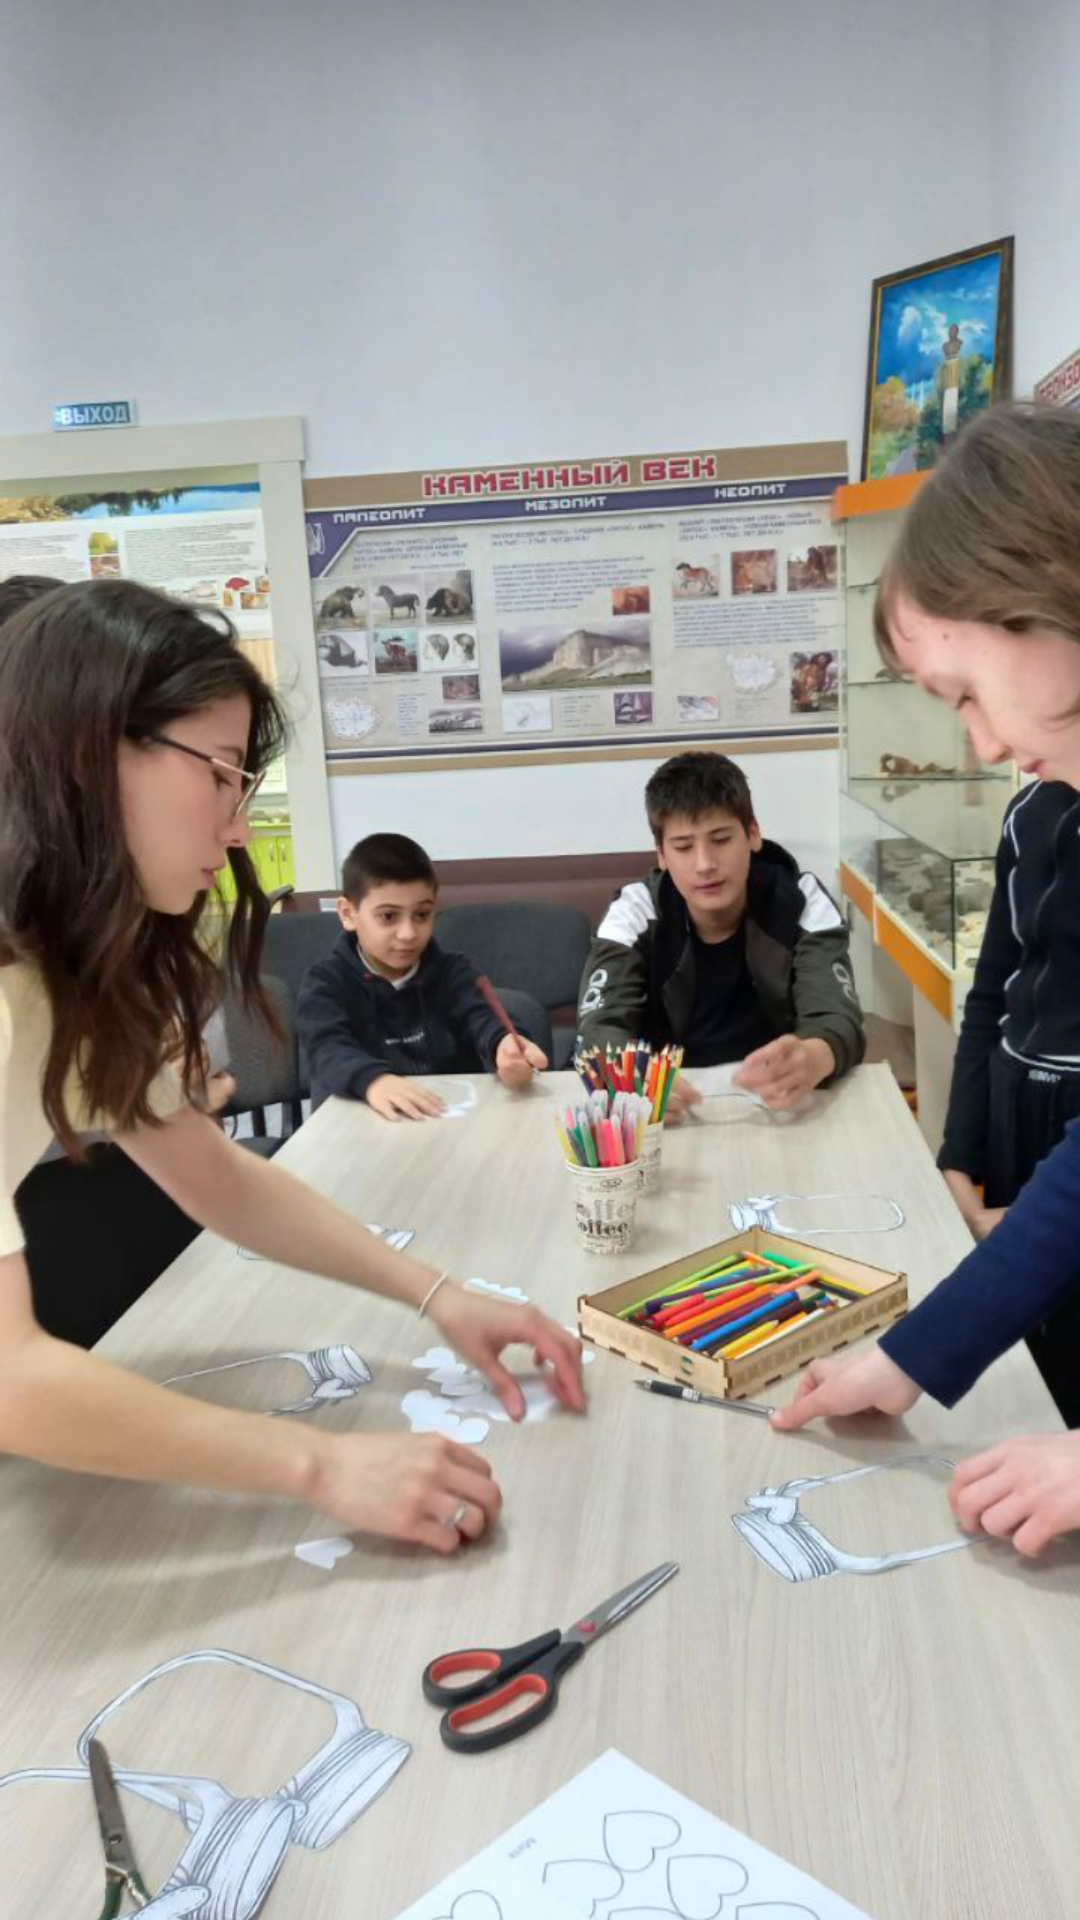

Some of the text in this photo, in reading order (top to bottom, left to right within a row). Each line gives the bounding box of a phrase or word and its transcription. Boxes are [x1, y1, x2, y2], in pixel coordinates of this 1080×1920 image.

[60, 405, 128, 426] ВЫХОД
[424, 456, 716, 496] КАМЕННЫЙ ВЕК
[714, 483, 786, 499] НЕОЛИТ
[525, 496, 606, 511] МЕЗОЛИТ
